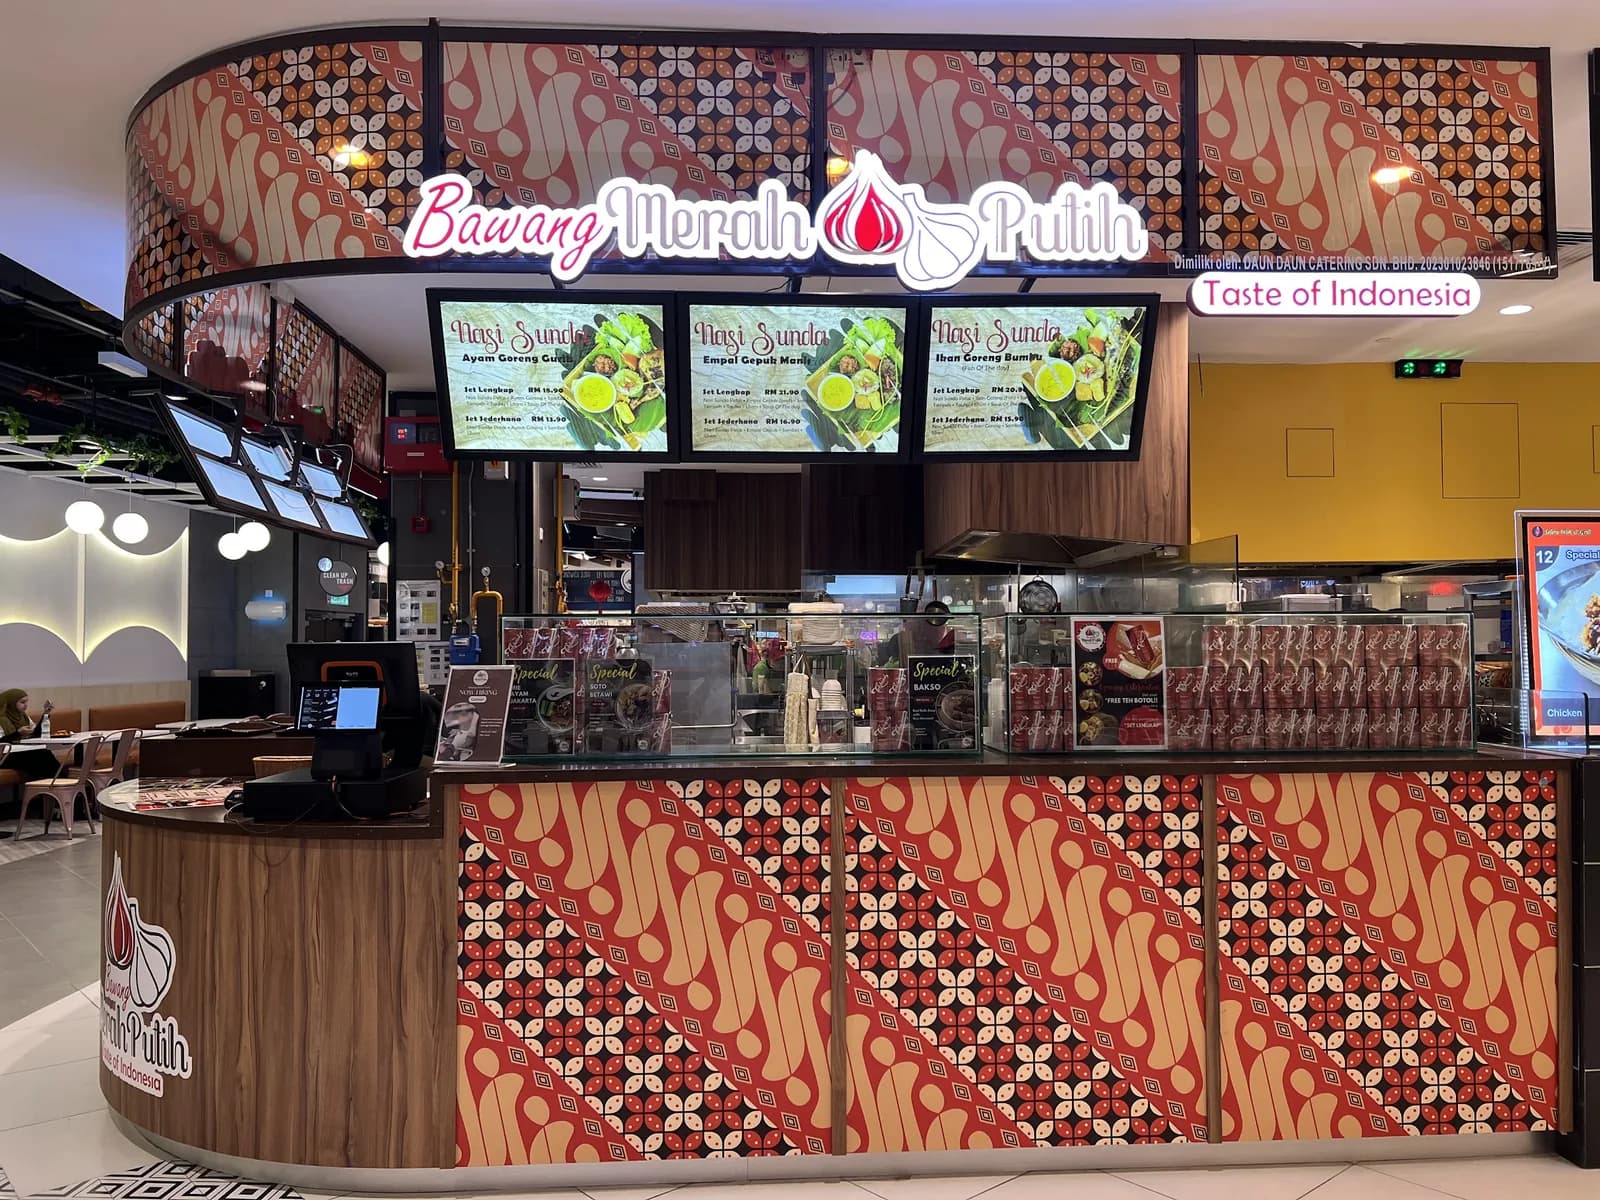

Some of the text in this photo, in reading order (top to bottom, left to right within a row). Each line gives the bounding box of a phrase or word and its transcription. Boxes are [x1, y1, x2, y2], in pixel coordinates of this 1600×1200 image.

[412, 181, 1141, 271] Bawang Merah Putih
[1174, 255, 1215, 270] Dimiliki
[1244, 255, 1273, 271] DAUN
[1276, 255, 1306, 271] DAUN
[1308, 255, 1363, 271] CATERING
[1365, 255, 1390, 271] SDN.
[1393, 255, 1418, 271] BHD.
[1203, 279, 1471, 306] Taste of Indonesia
[451, 319, 589, 354] Nasi Sunda
[694, 321, 829, 356] Nasi Sunda
[932, 318, 1061, 354] Nasi Sunda
[462, 353, 495, 364] Ayam
[499, 353, 539, 364] Goreng
[703, 355, 738, 366] Empal
[741, 355, 777, 366] Gepuk
[935, 353, 960, 362] Ikan
[963, 352, 1002, 363] Goreng
[1536, 549, 1600, 564] 12 Special
[590, 662, 638, 684] Special
[913, 660, 960, 681] Special
[913, 683, 942, 691] BAKSO
[1546, 708, 1583, 718] Chicken
[126, 1010, 189, 1074] Putih
[120, 1056, 161, 1092] Indonesia
